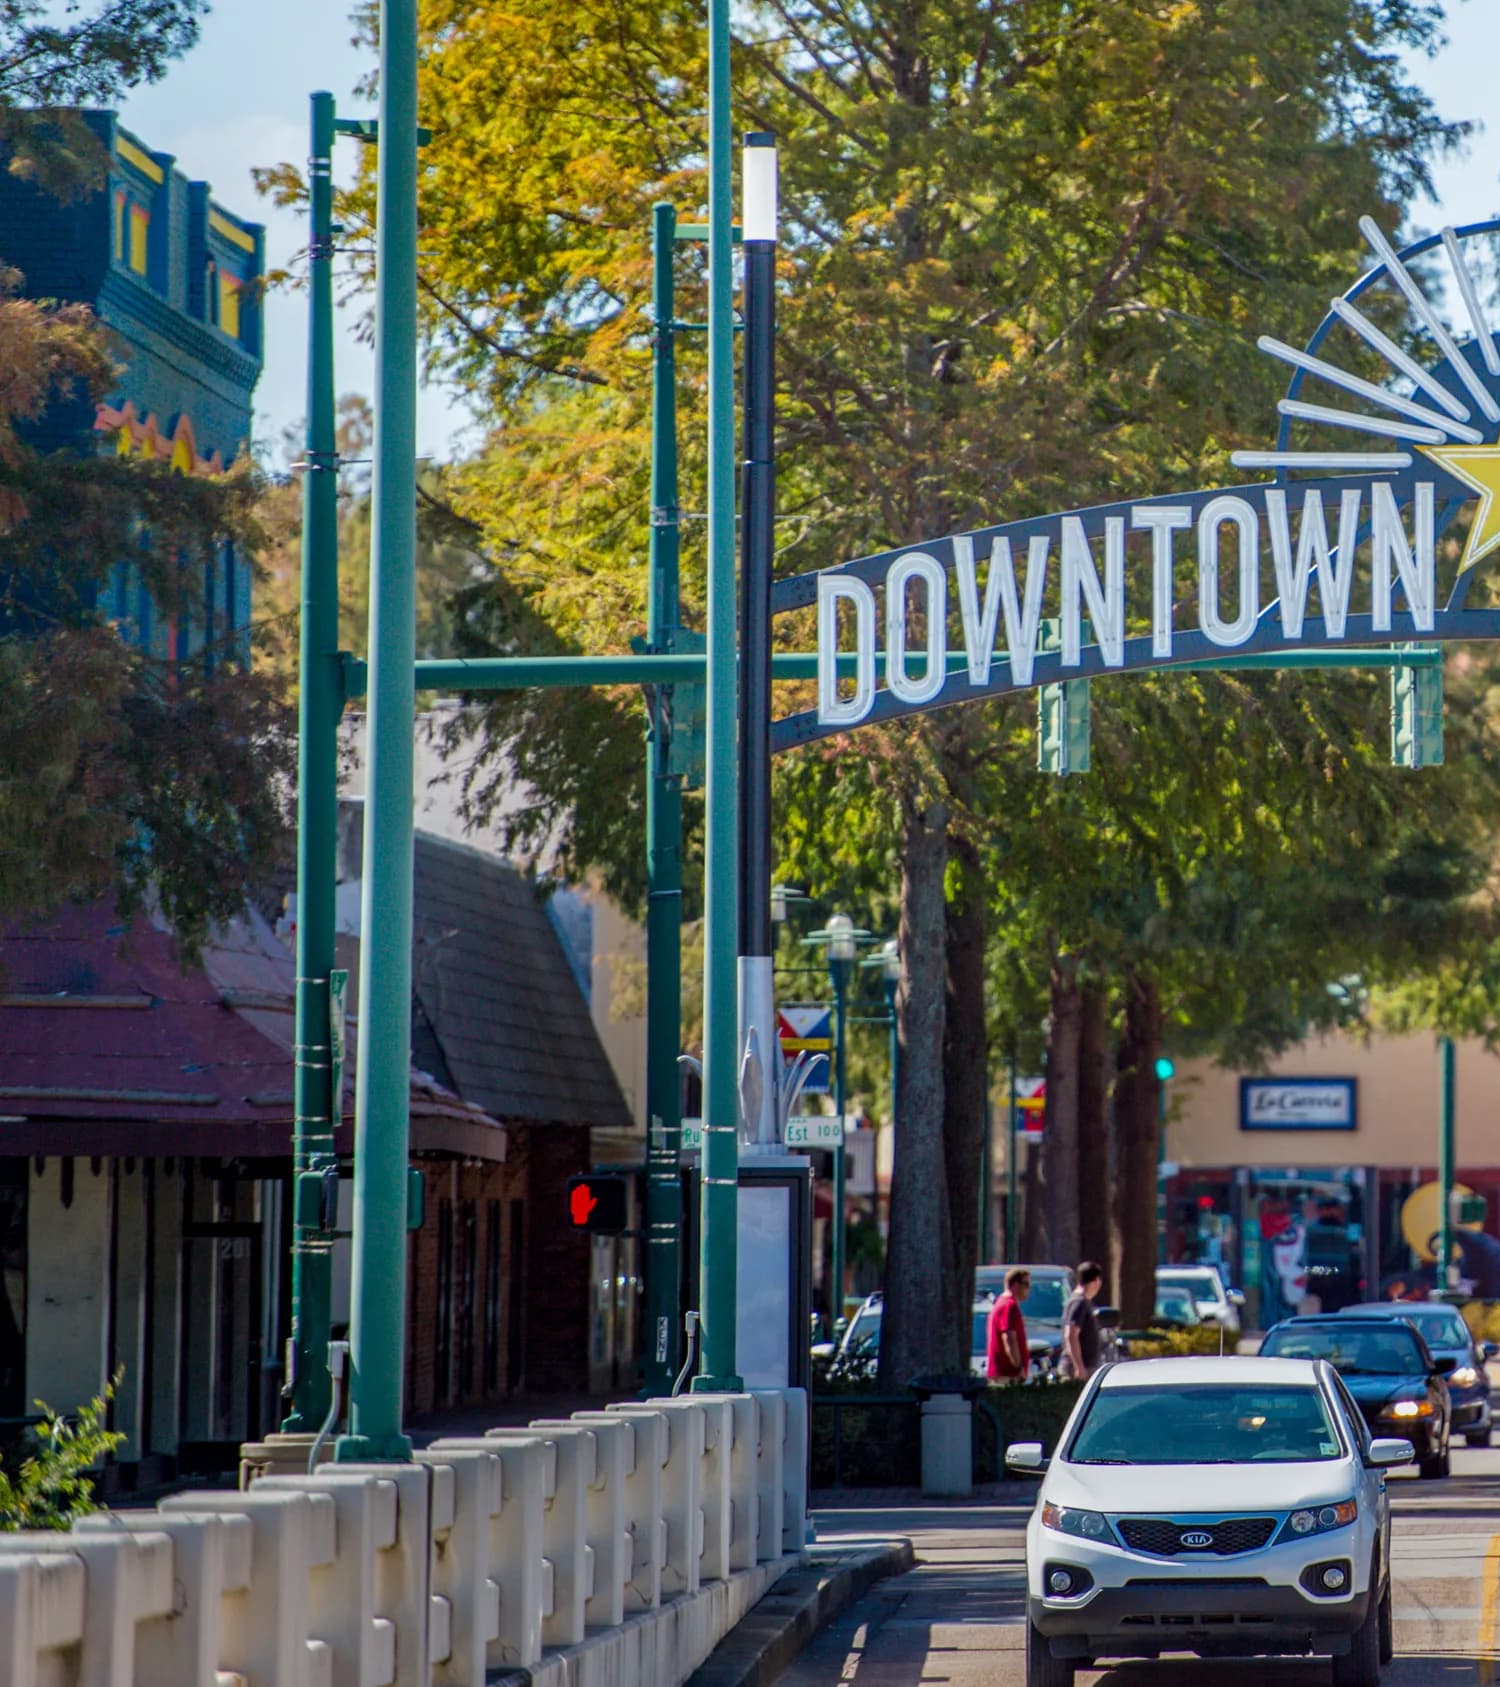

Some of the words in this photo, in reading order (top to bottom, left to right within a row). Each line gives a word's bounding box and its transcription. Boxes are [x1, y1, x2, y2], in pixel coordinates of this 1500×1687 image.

[817, 482, 1435, 726] DOWNTOWN
[684, 1127, 701, 1143] Ru
[787, 1126, 808, 1142] Est
[818, 1125, 840, 1137] 100
[1187, 1535, 1208, 1545] KIA
